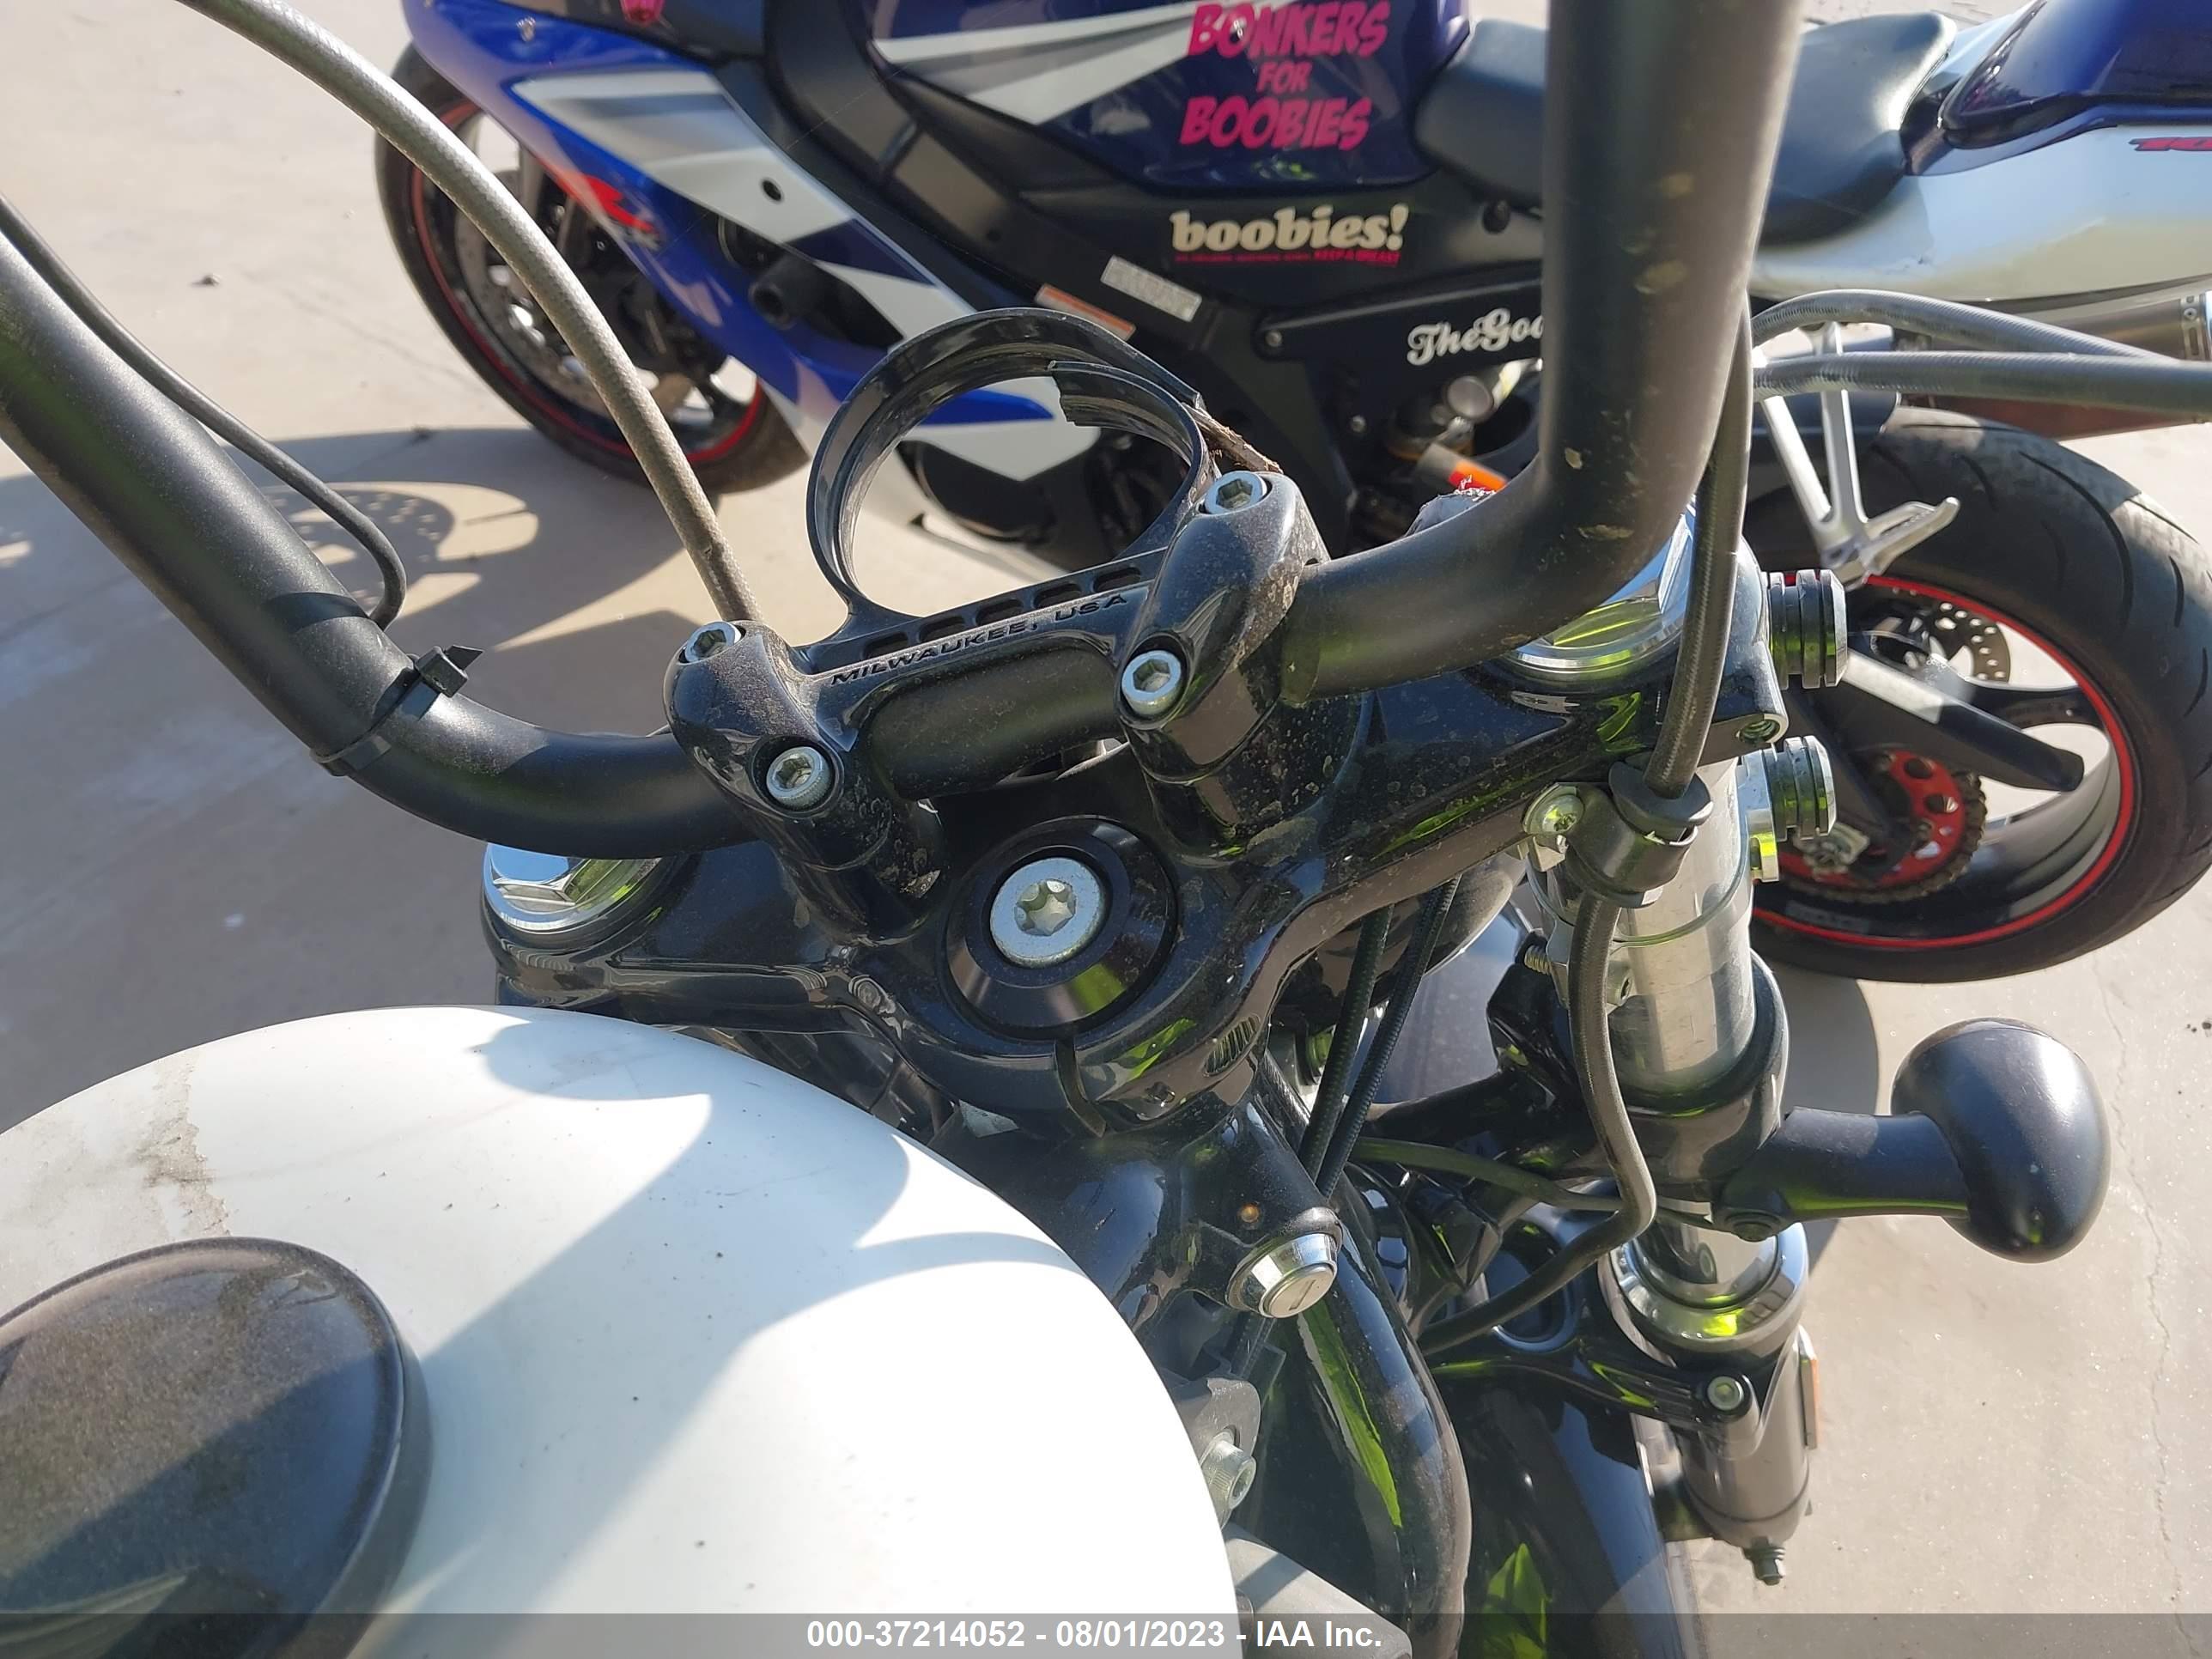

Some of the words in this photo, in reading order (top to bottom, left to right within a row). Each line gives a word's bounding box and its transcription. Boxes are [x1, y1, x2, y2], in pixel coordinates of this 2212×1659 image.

[1188, 2, 1390, 58] BONKERS
[1256, 61, 1313, 94] FOR
[1180, 95, 1372, 151] BOOBIES
[1169, 203, 1409, 252] boobies!
[830, 623, 1038, 686] MILWAUKEE,
[1054, 594, 1127, 622] USA
